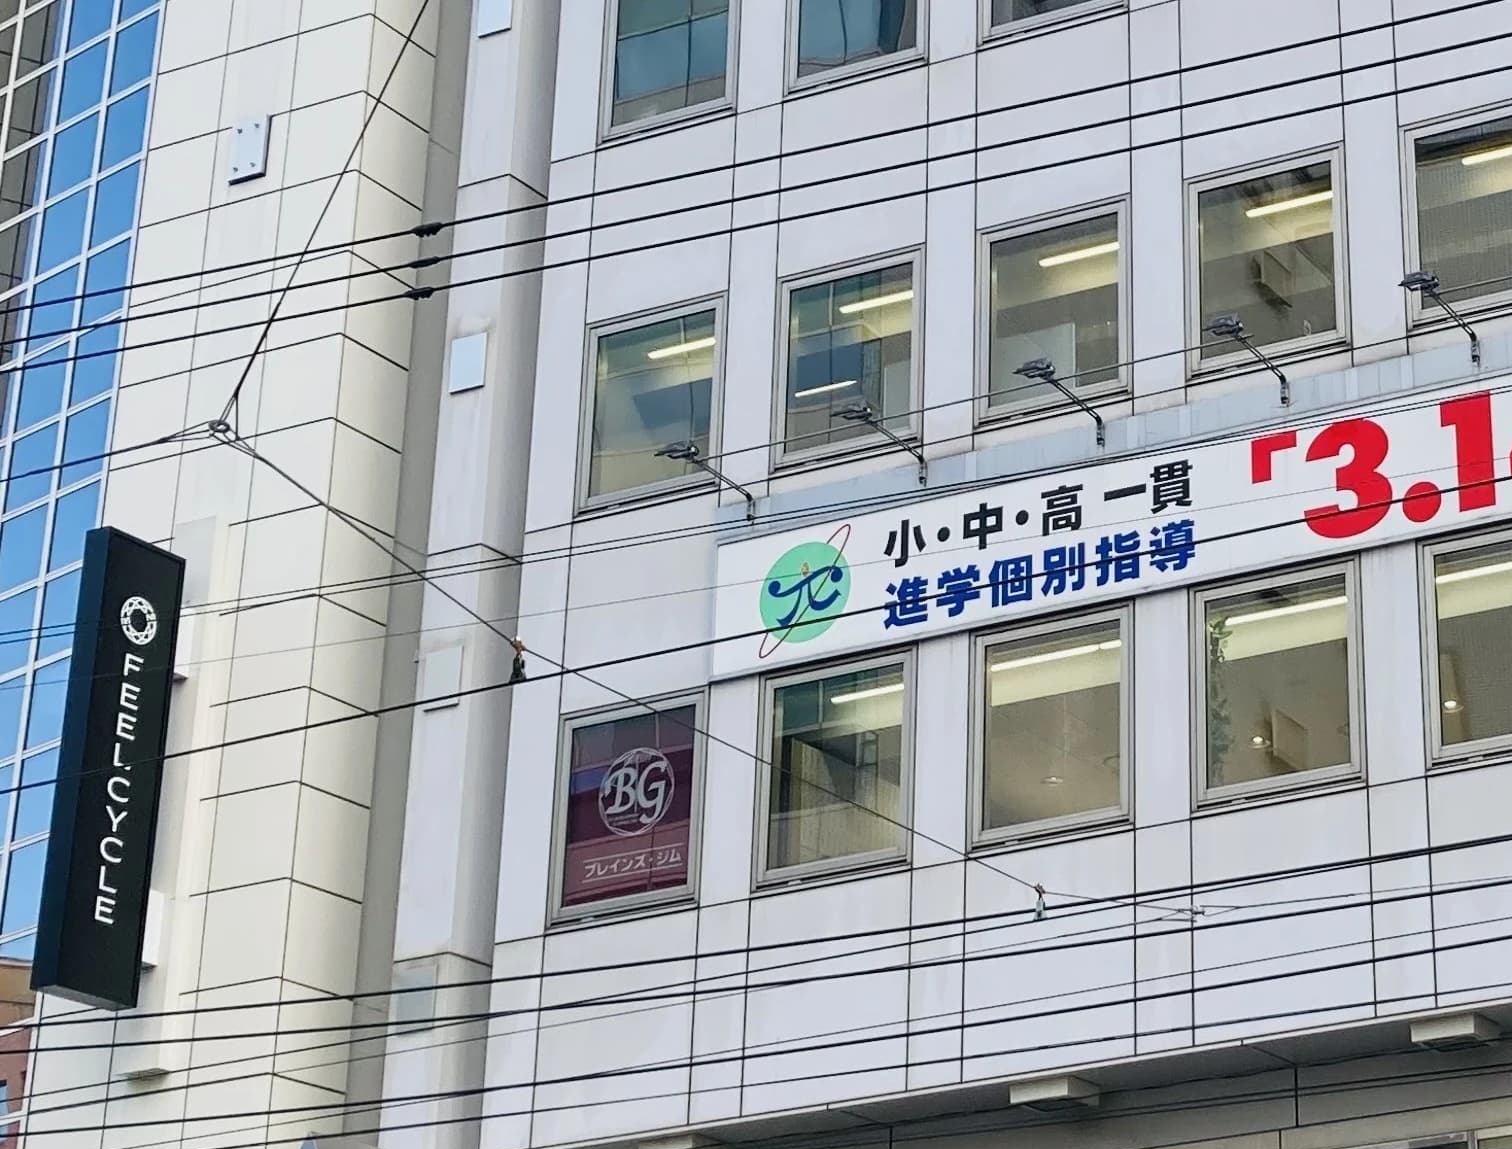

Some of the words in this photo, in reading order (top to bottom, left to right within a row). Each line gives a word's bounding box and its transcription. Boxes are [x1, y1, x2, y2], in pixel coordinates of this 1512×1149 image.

[882, 519, 1197, 631] 進学個別指導
[94, 651, 145, 926] FEELCYCLE
